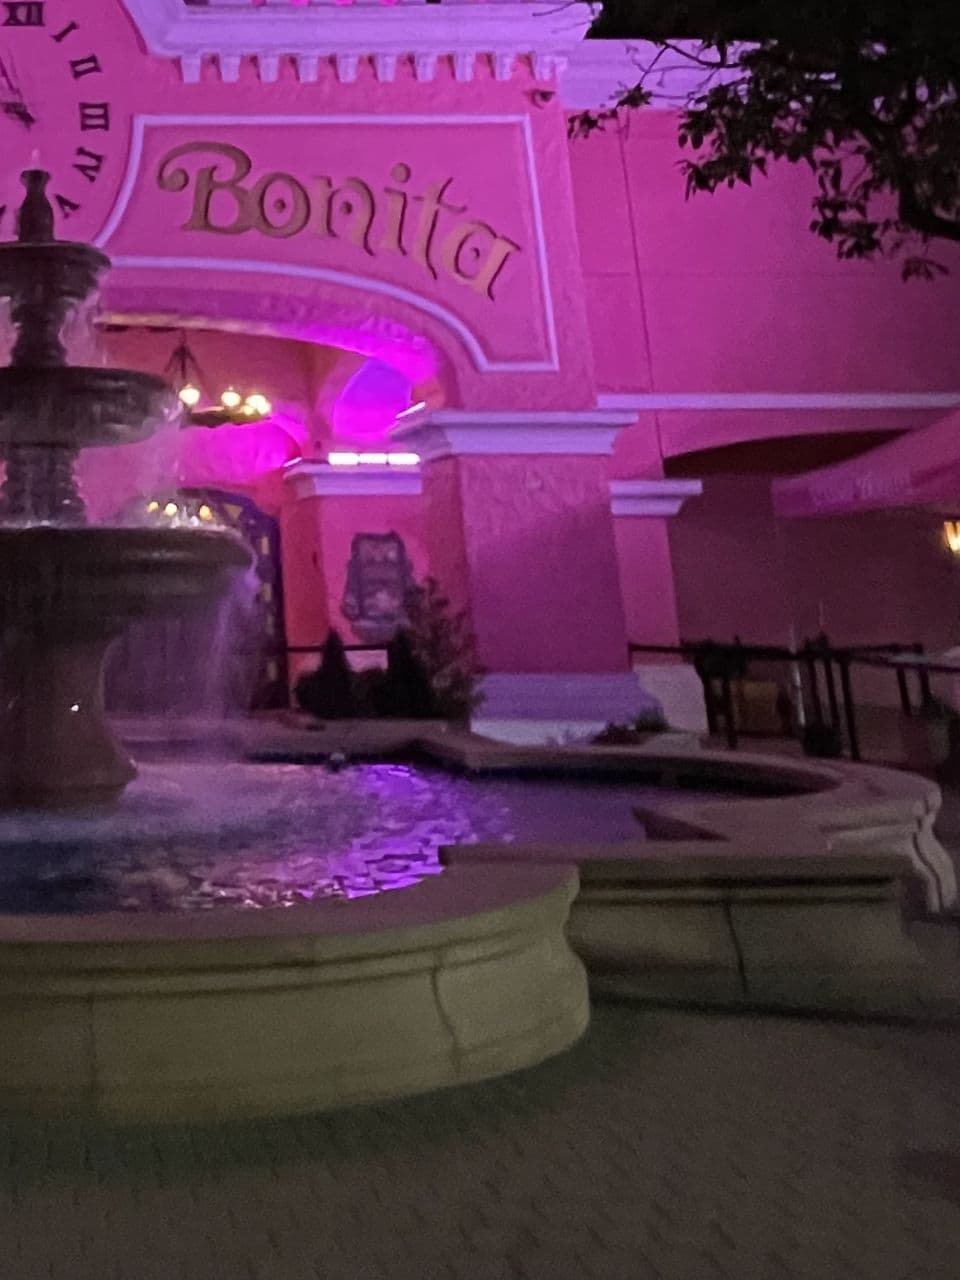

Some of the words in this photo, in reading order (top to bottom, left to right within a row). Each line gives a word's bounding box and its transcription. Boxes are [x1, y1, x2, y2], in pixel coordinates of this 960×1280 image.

[2, 0, 45, 26] XII
[70, 54, 102, 80] II
[79, 102, 109, 131] III
[156, 141, 521, 301] Bonita
